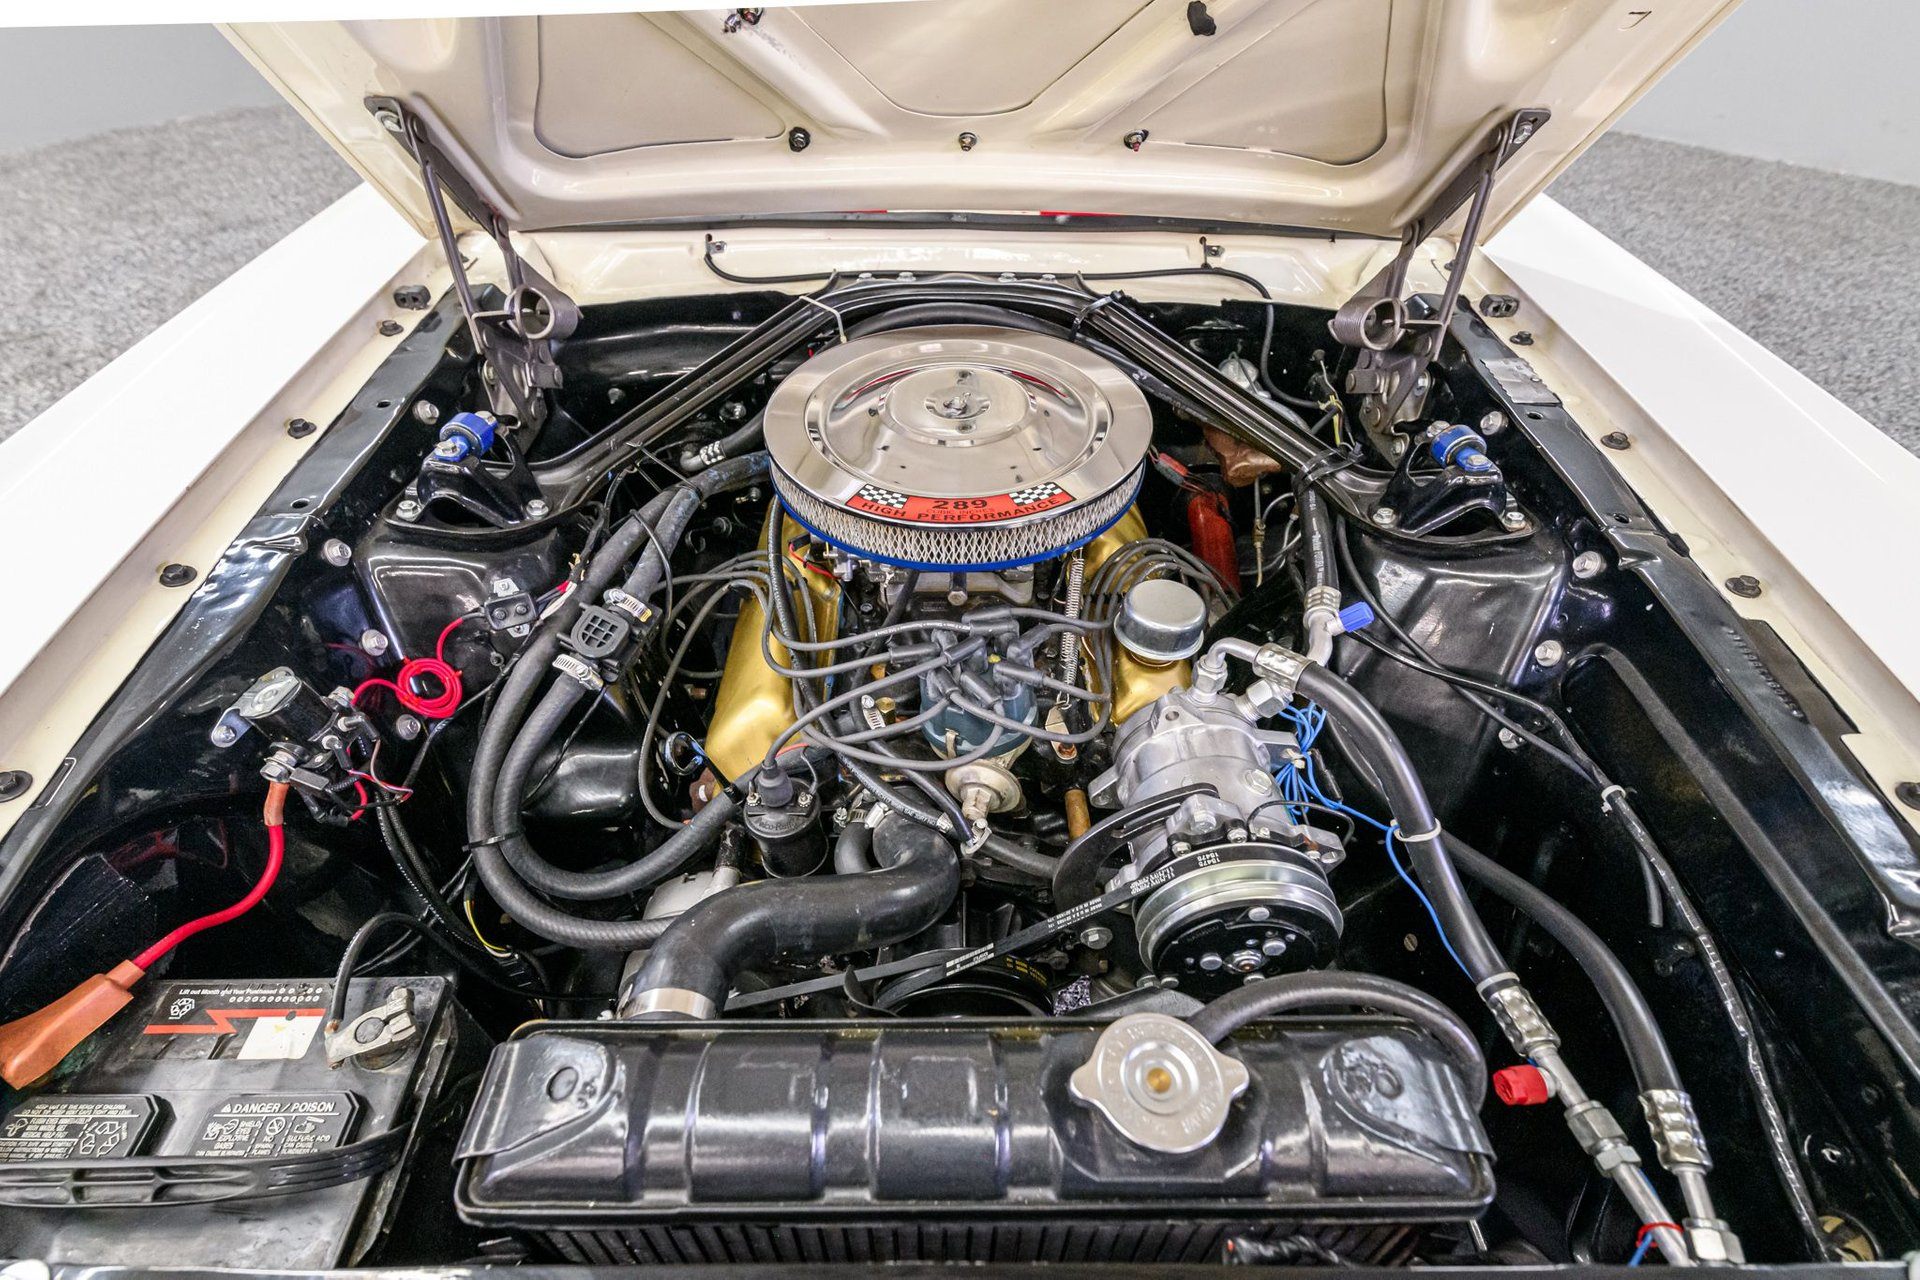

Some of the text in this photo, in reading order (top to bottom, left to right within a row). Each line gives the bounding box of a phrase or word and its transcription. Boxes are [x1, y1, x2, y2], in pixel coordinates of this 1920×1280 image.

[861, 498, 1060, 521] HIGH PERFORMANCE
[932, 500, 987, 510] 289
[233, 1101, 335, 1113] DANGER / POISON
